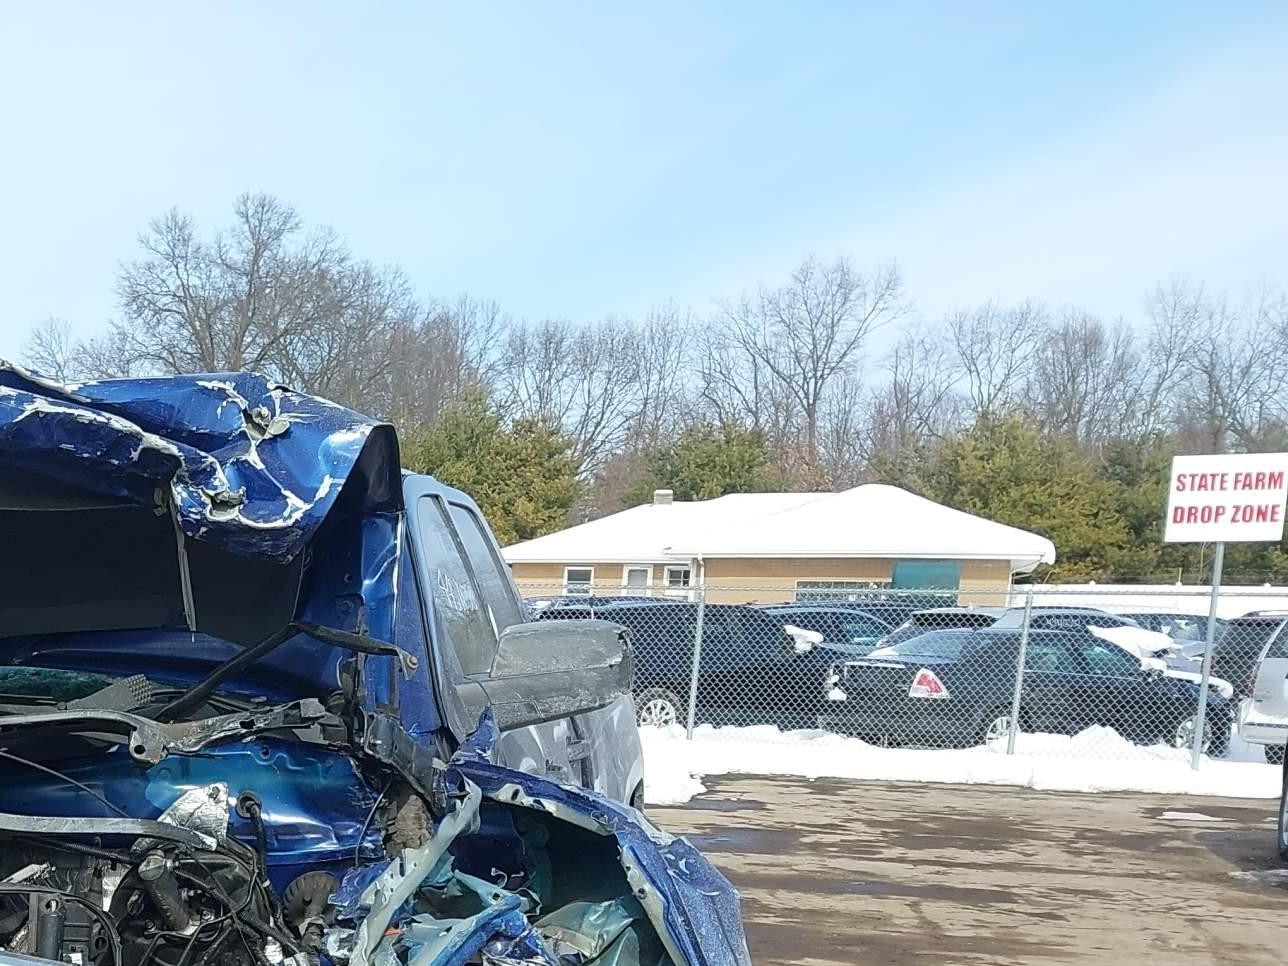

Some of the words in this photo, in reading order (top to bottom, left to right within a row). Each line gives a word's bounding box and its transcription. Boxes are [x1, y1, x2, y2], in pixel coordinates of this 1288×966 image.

[1175, 472, 1229, 492] STATE
[1233, 471, 1285, 491] FARM
[1172, 505, 1226, 524] DROP
[1230, 504, 1281, 524] ZONE
